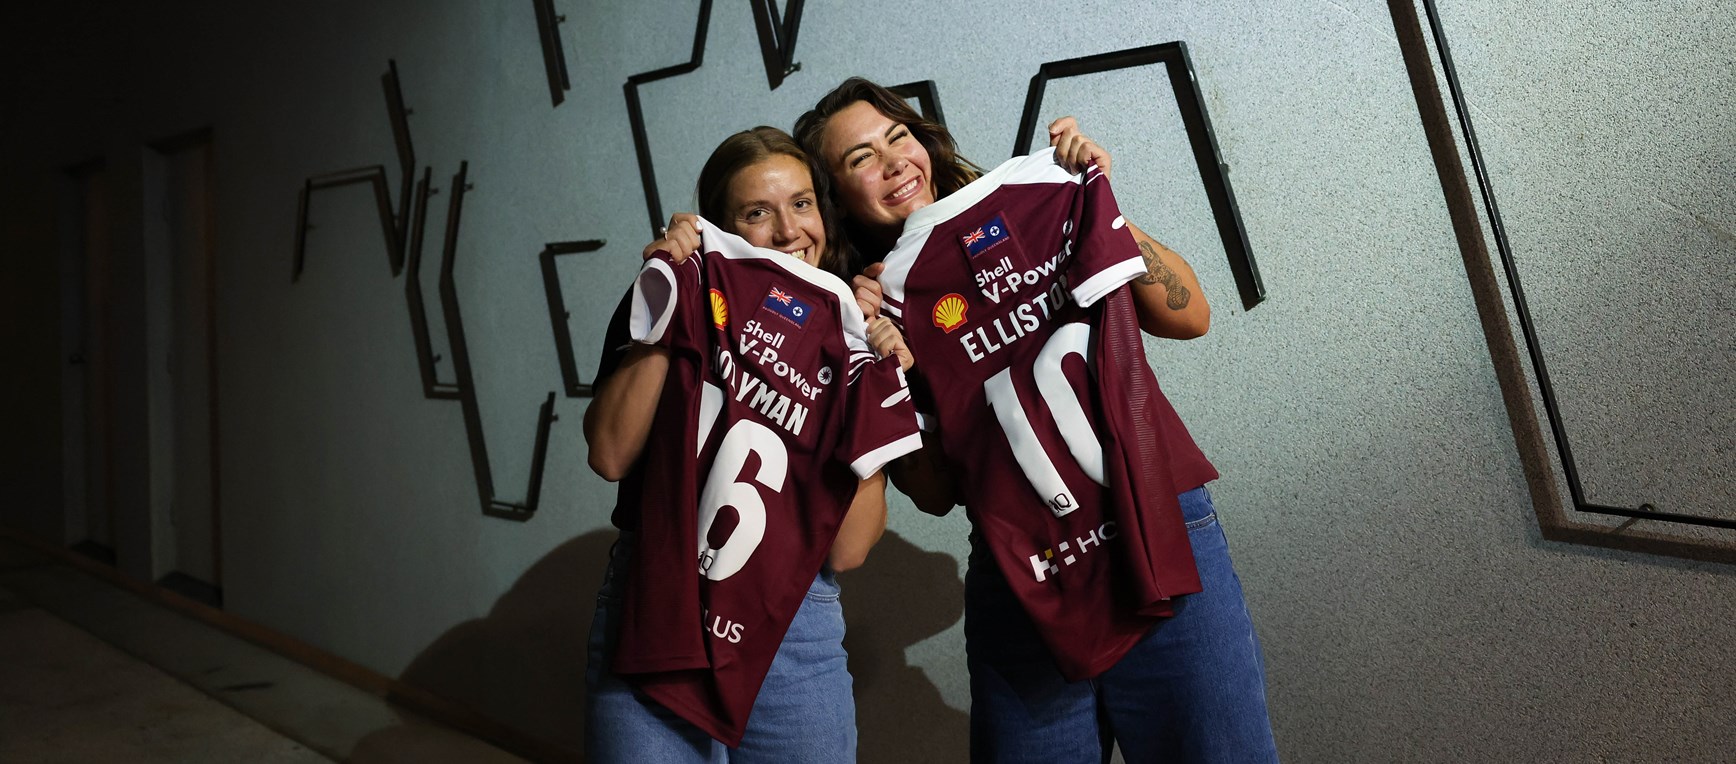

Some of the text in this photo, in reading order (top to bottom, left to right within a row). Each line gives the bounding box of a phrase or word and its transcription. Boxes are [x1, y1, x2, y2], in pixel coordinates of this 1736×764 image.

[975, 256, 1014, 288] Shell
[981, 239, 1072, 305] V-Power
[740, 333, 822, 401] V-Power
[743, 319, 785, 349] Shell
[984, 322, 1107, 518] 10
